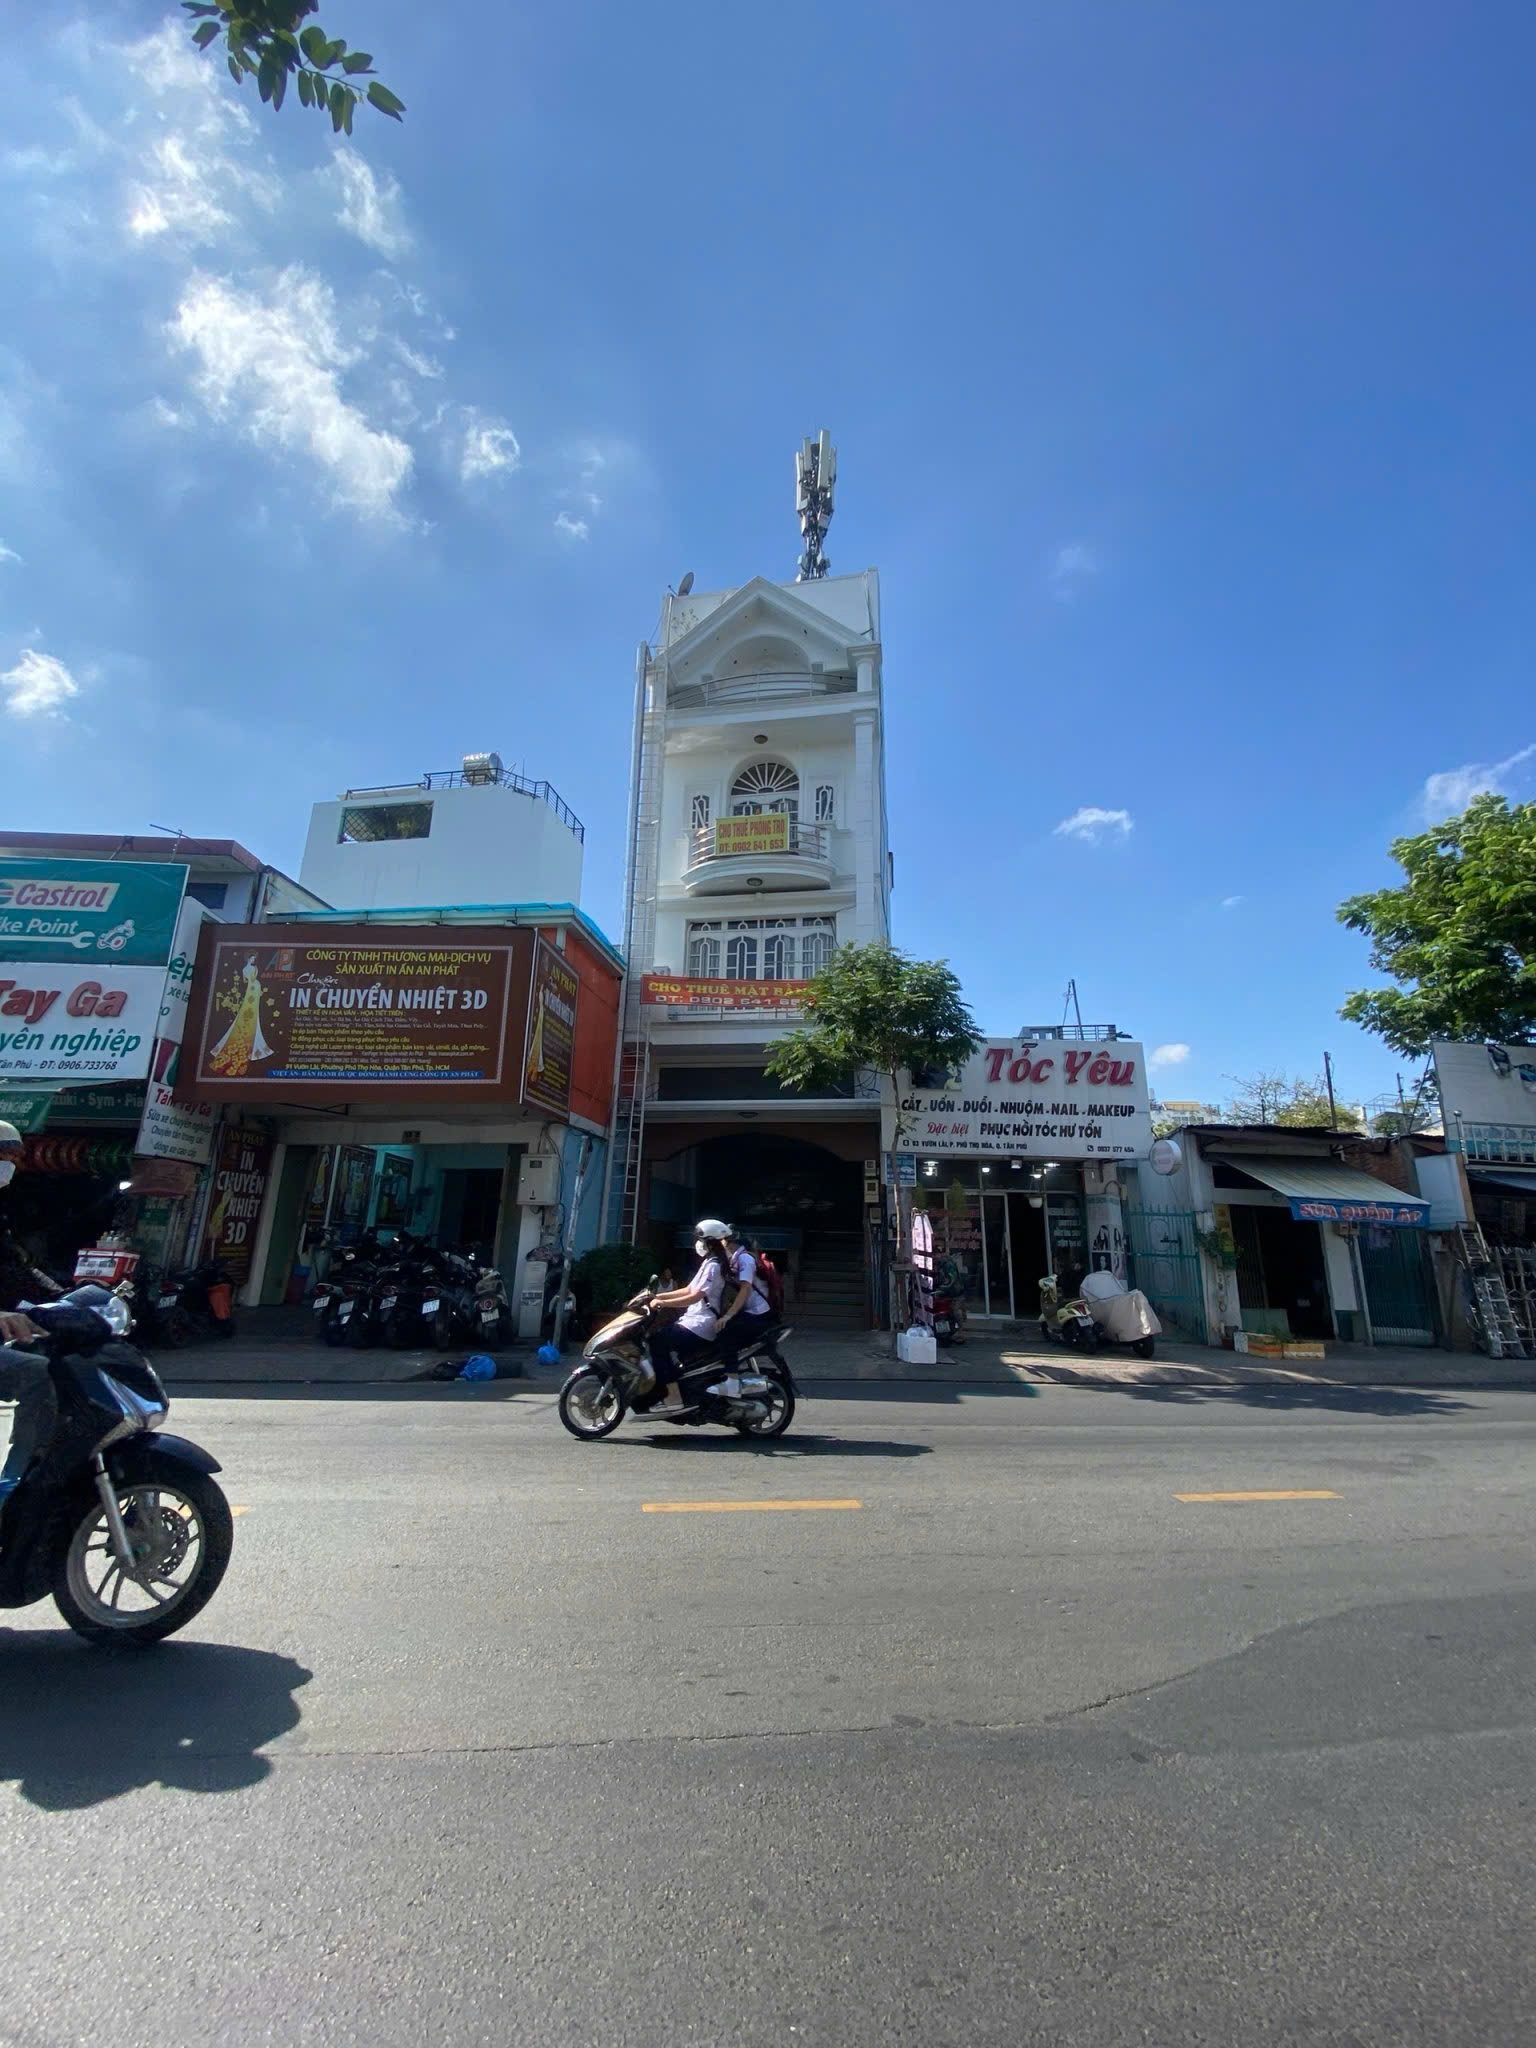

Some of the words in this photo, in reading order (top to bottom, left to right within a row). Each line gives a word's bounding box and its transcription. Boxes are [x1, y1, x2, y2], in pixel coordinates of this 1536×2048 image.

[719, 823, 732, 838] CHO
[15, 883, 109, 908] Castrol
[26, 918, 79, 934] Point
[306, 949, 336, 960] CÔNG
[336, 951, 352, 961] TY
[352, 951, 380, 962] TNHH
[382, 951, 427, 962] THƯƠNG
[477, 952, 492, 965] VỤ
[335, 962, 357, 974] SẢN
[357, 962, 385, 975] XUẤT
[386, 965, 397, 975] IN
[398, 963, 414, 976] ẤN
[416, 966, 431, 976] AN
[433, 963, 460, 976] PHÁT
[648, 982, 681, 993] CHO
[686, 983, 730, 995] THUÊ
[66, 981, 128, 1017] Ga
[289, 987, 311, 1008] IN
[316, 982, 393, 1009] CHUYỂN
[398, 986, 458, 1015] NHIỆT
[461, 989, 488, 1010] 3D
[689, 995, 734, 1005] 0902
[50, 1028, 141, 1058] nghiệp
[58, 1061, 117, 1071] 0906.733768
[985, 1048, 1054, 1084] Tóc
[1062, 1050, 1136, 1086] Yêu
[88, 1093, 115, 1109] Sym
[901, 1093, 922, 1111] CẮT
[929, 1094, 955, 1112] UỐN
[1000, 1100, 1044, 1118] NHUỘM
[1051, 1103, 1079, 1116] NAIL
[1087, 1104, 1135, 1118] MAKEUP
[980, 1123, 1011, 1139] PHỤC
[1012, 1120, 1033, 1137] HỒI
[1035, 1121, 1057, 1137] TÓC
[1060, 1123, 1077, 1138] HƯ
[1078, 1120, 1102, 1138] TỔN
[240, 1150, 255, 1170] IN
[224, 1222, 248, 1244] 3D
